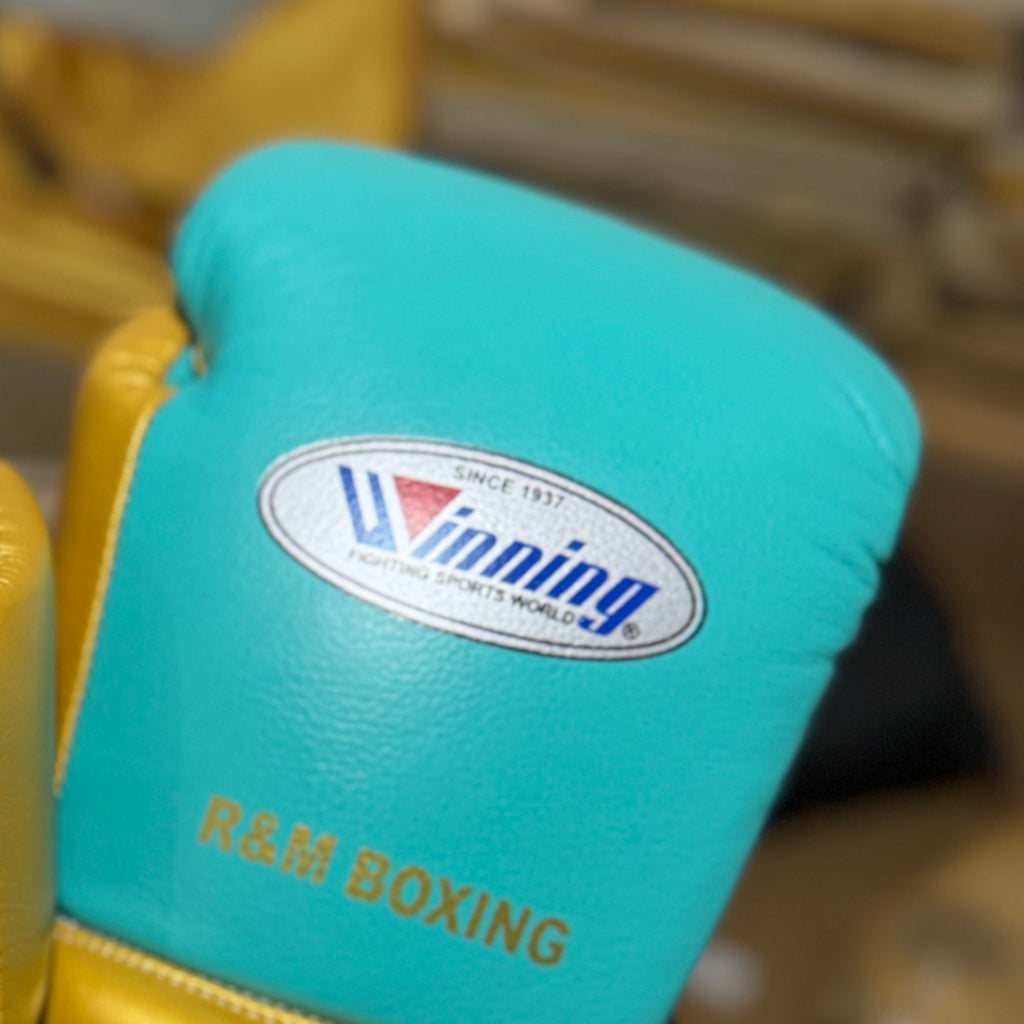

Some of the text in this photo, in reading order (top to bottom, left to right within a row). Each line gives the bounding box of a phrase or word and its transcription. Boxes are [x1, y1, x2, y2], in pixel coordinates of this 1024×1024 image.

[338, 464, 660, 637] Winning
[453, 466, 566, 510] SINCE 1937
[348, 548, 576, 626] FIGHTING SPORTS WORLD
[197, 794, 570, 968] R&M BOXING
